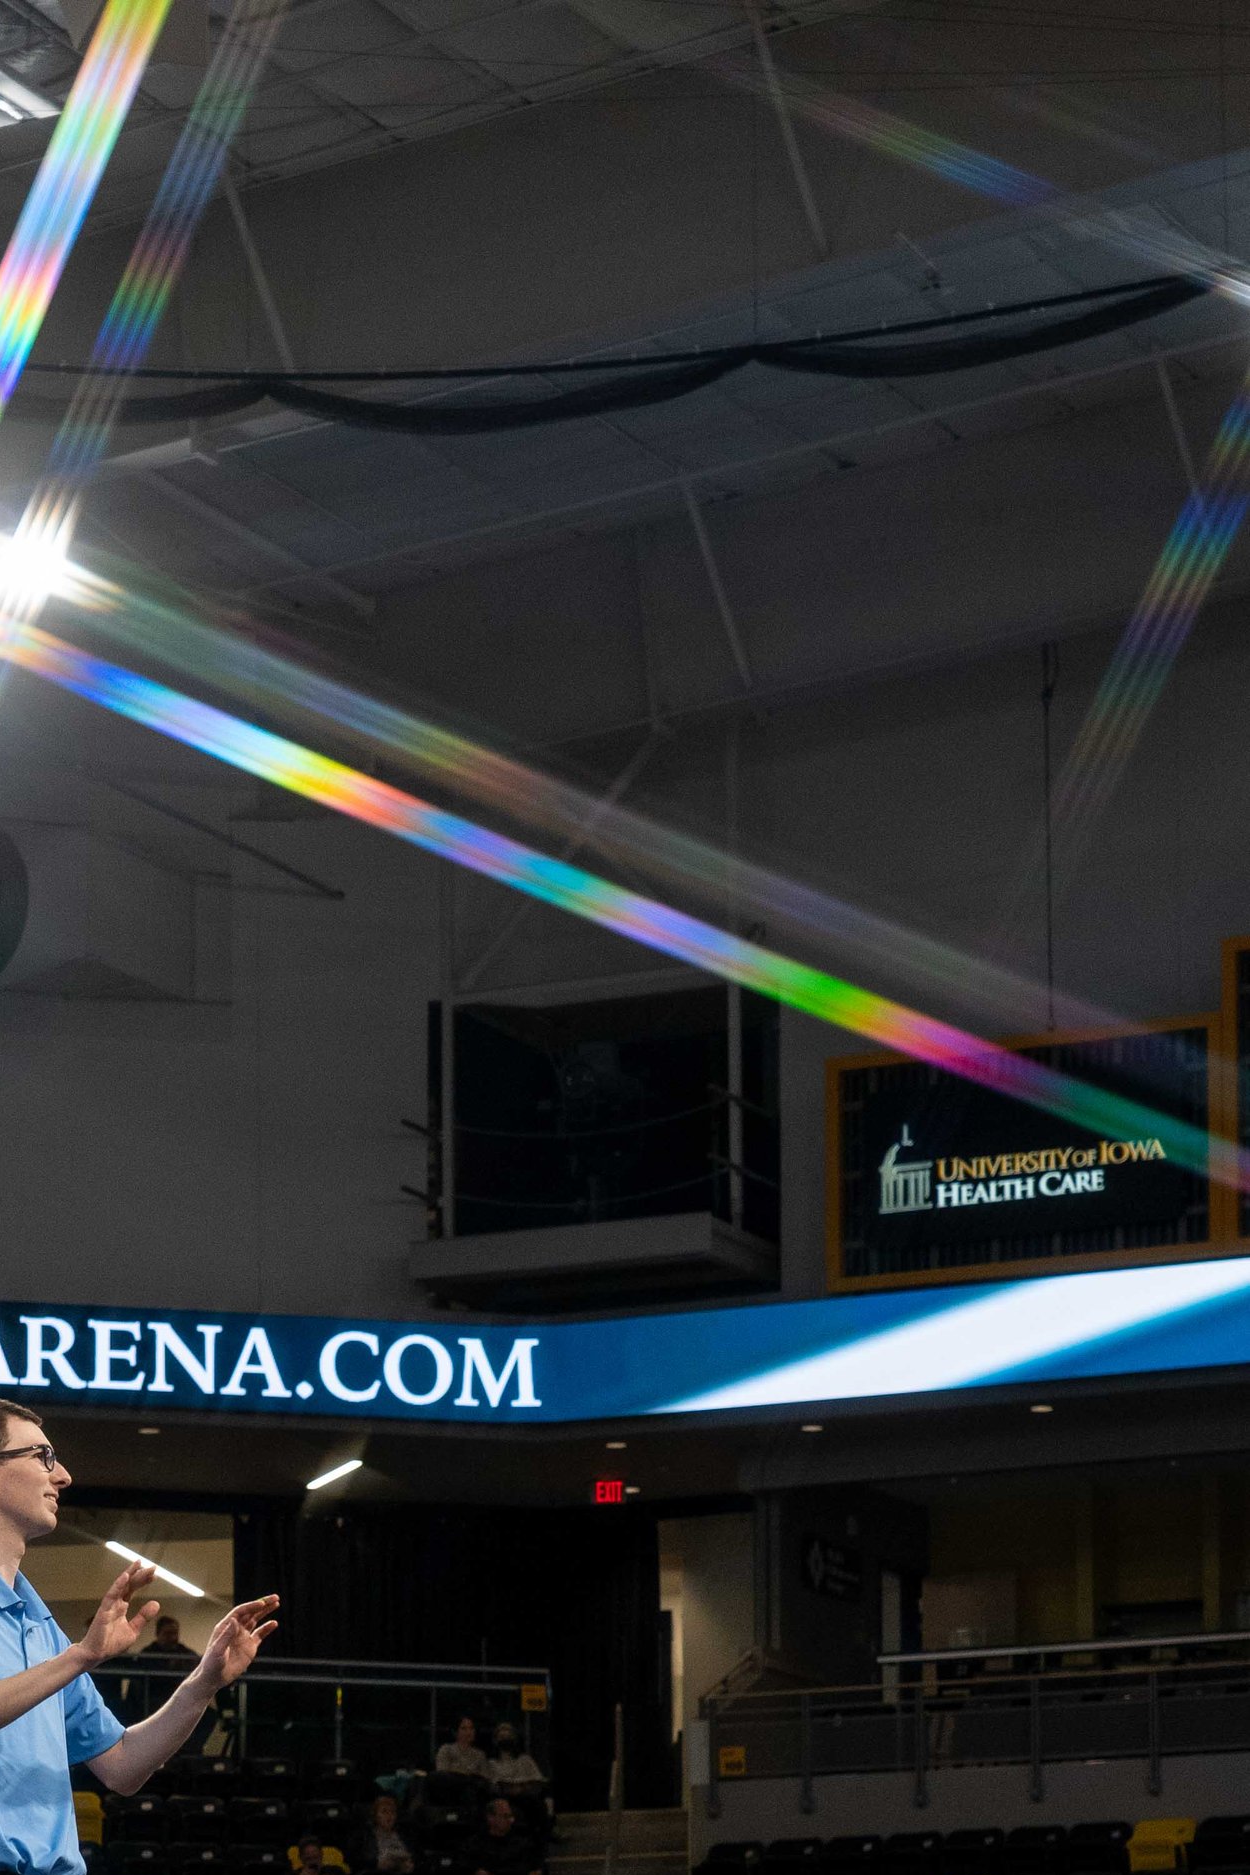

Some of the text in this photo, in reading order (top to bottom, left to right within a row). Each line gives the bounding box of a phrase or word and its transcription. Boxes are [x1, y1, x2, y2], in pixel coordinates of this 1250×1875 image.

[935, 1146, 1073, 1183] UNIVERSITY
[1099, 1138, 1167, 1167] IOWA
[935, 1169, 1105, 1209] HEALTH CARE
[595, 1480, 623, 1503] EXIT
